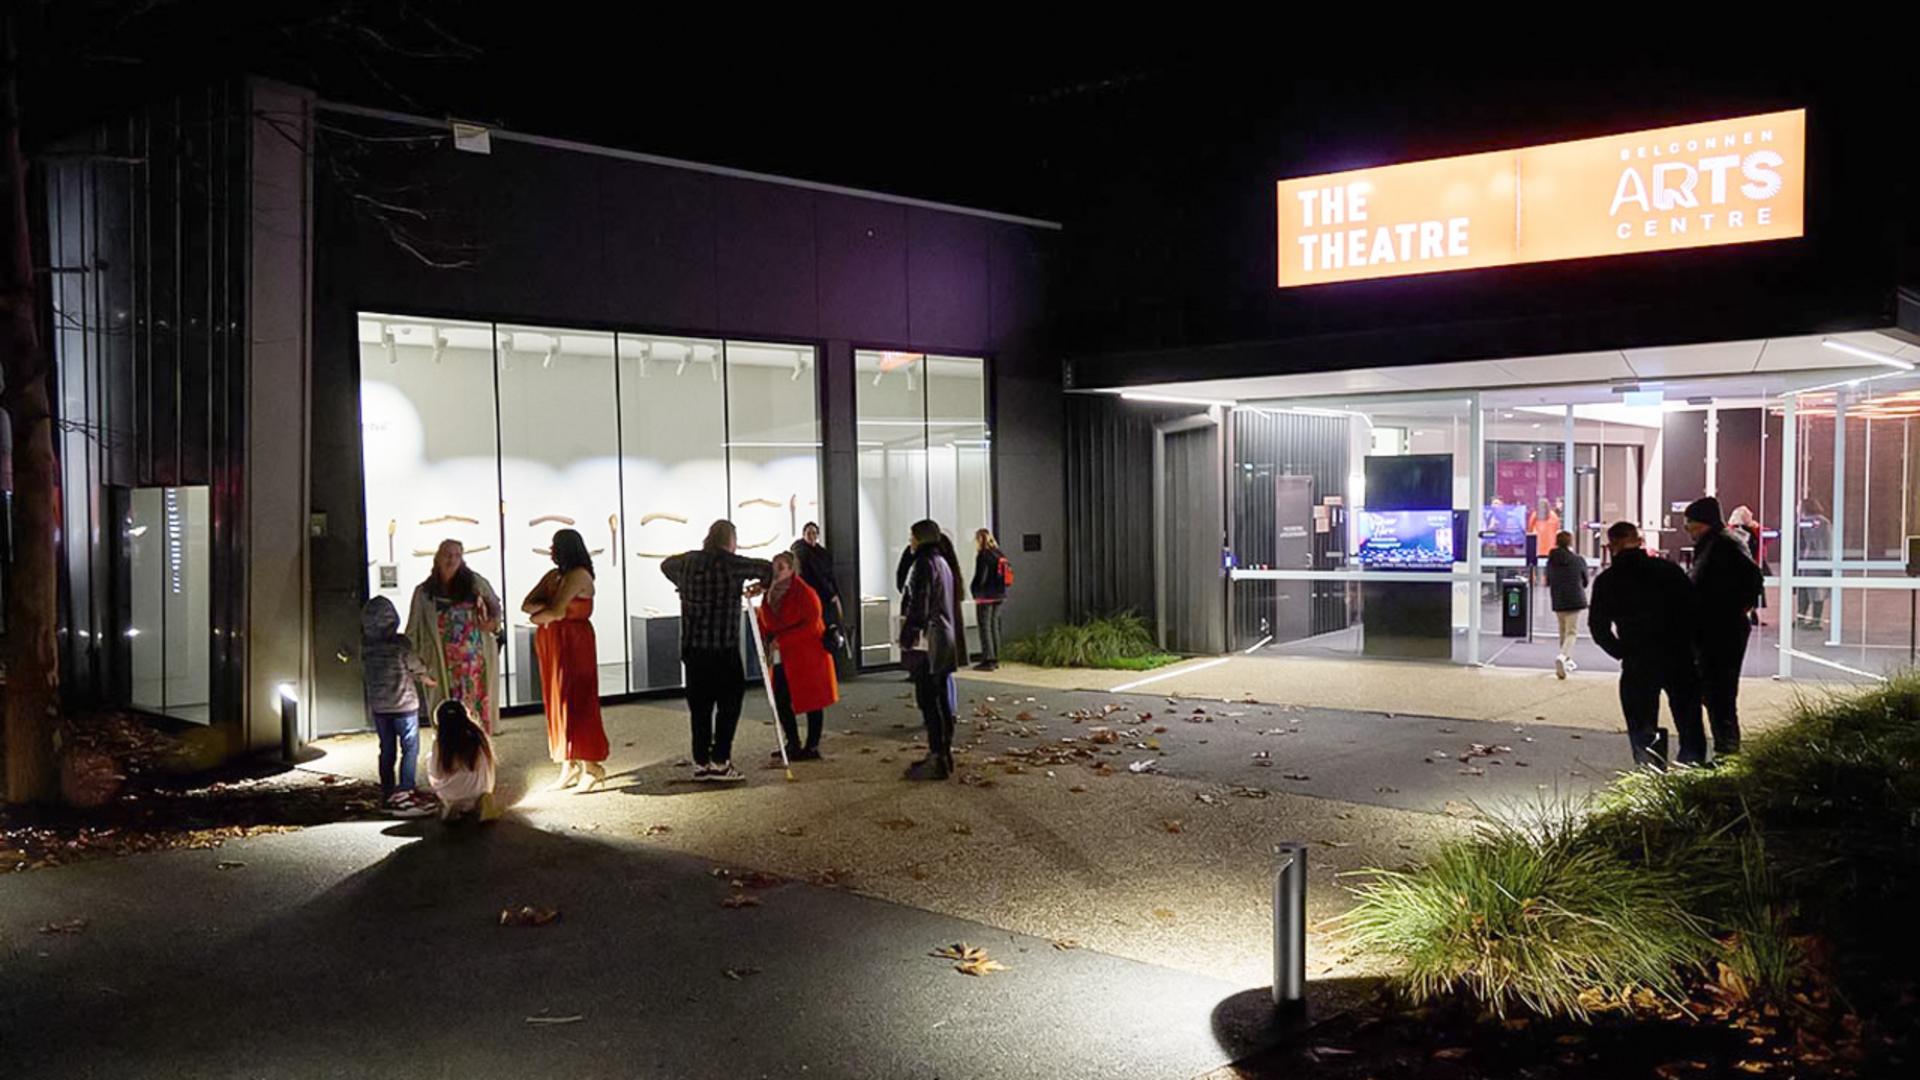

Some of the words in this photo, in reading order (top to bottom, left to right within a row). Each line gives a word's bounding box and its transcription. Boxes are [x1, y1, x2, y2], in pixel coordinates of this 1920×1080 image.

[1620, 130, 1773, 161] BELCONNEN
[1297, 181, 1369, 228] THE
[1609, 150, 1784, 216] ARTS
[1297, 217, 1470, 272] THEATRE
[1616, 207, 1772, 240] CENTRE
